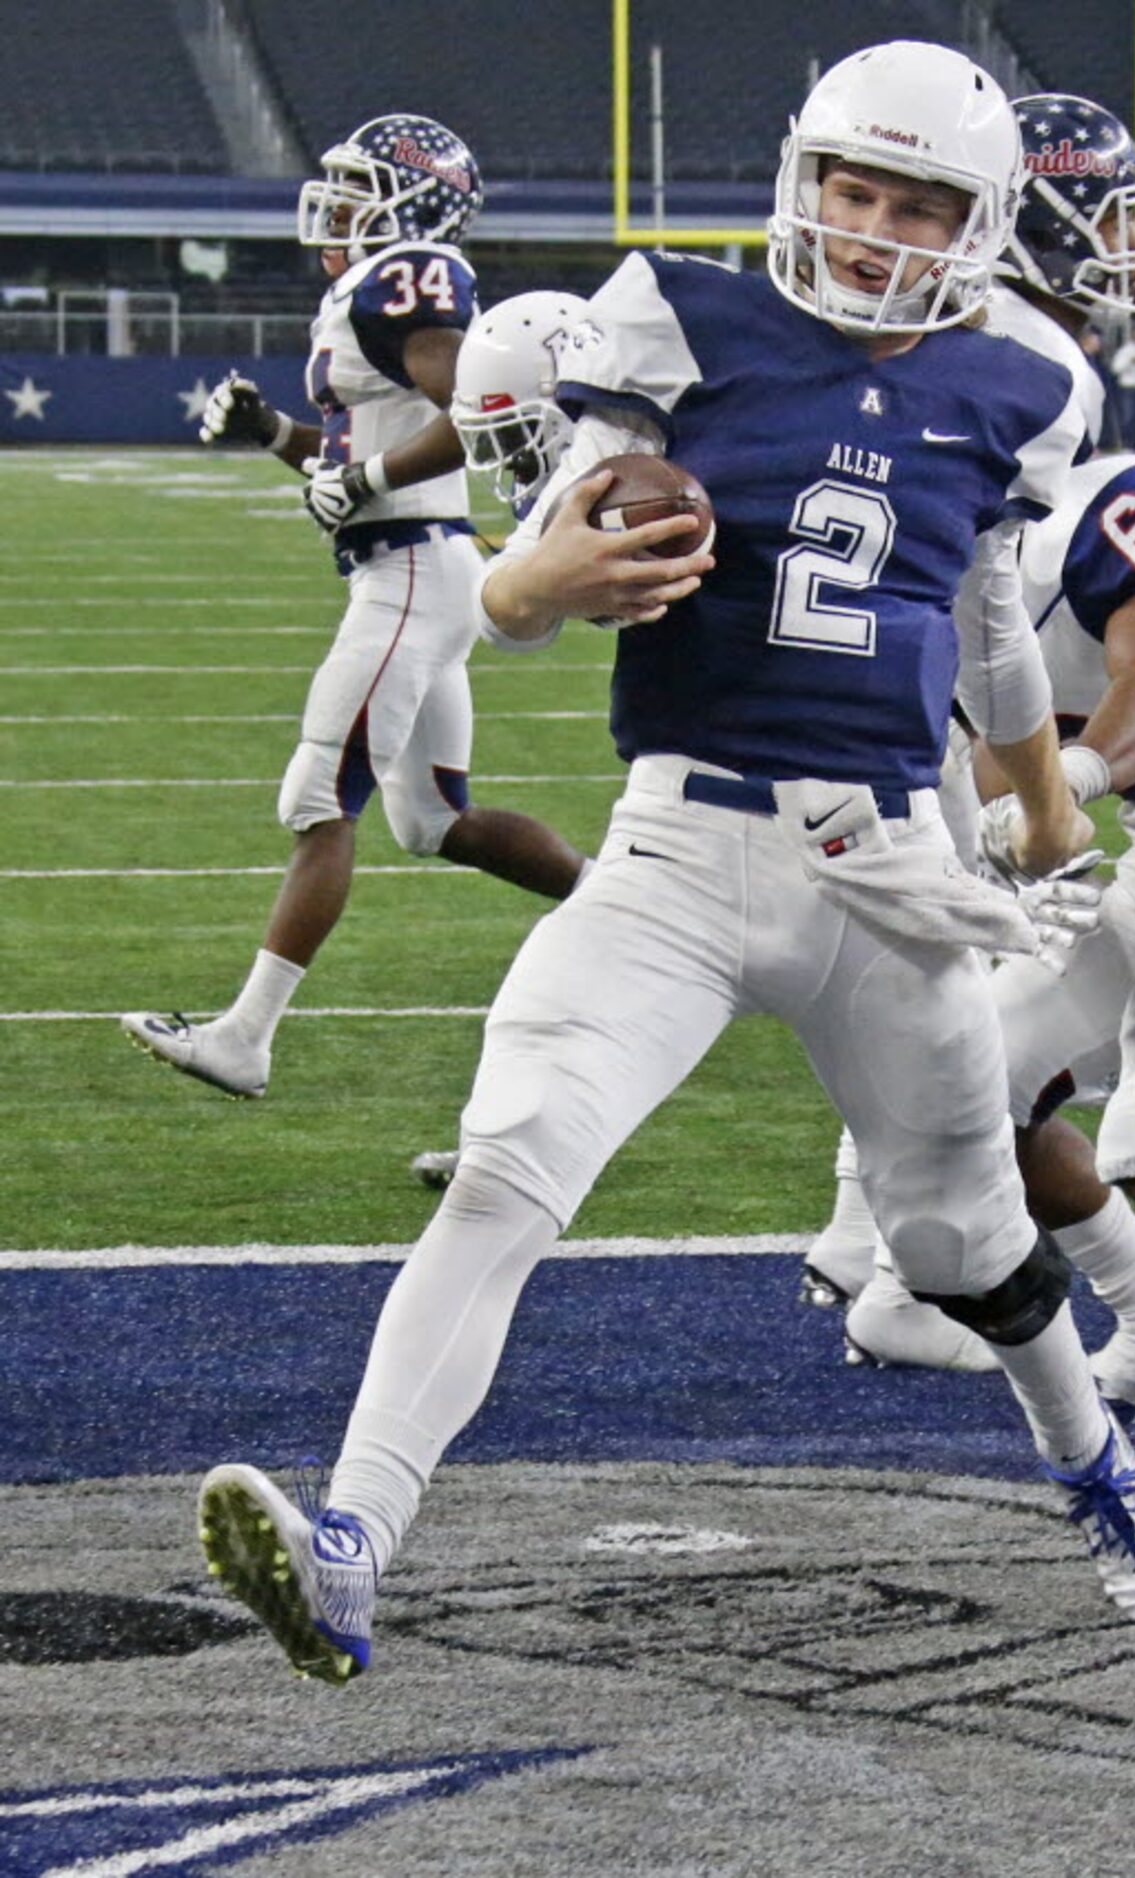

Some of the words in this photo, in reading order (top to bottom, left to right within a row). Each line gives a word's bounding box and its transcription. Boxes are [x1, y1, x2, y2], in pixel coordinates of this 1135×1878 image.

[1023, 139, 1116, 177] aiders
[379, 258, 455, 316] 34
[860, 387, 883, 416] A
[826, 443, 892, 484] ALLEN
[767, 479, 897, 657] 2
